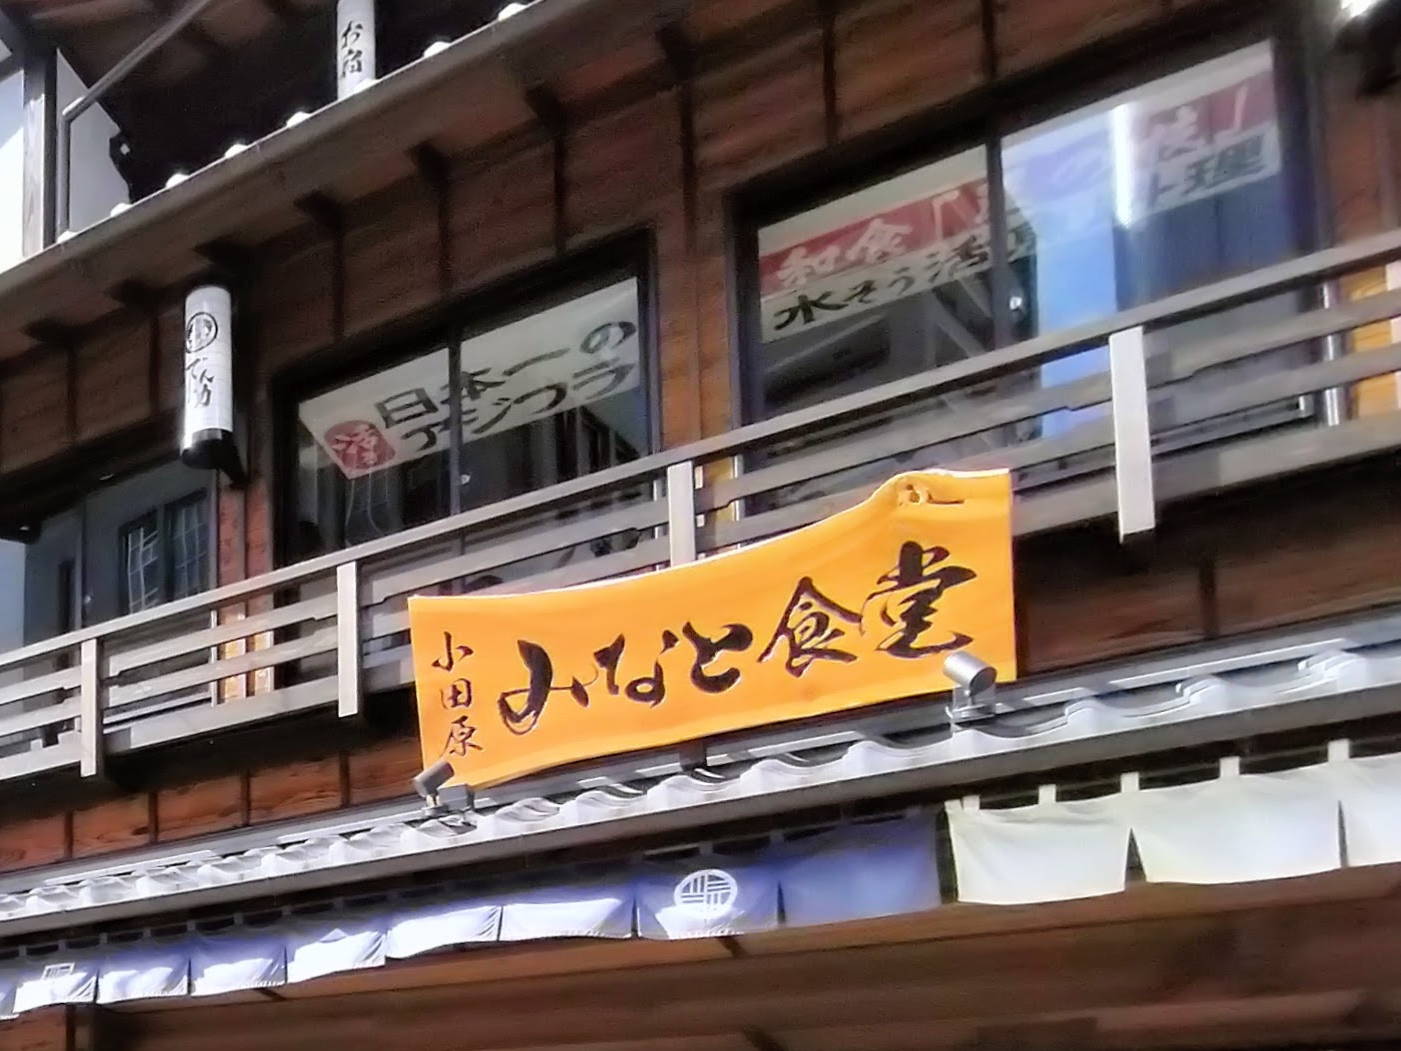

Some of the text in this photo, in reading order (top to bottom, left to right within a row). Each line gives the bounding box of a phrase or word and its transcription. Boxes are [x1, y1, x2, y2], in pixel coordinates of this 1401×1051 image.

[341, 20, 363, 79] お宿
[375, 320, 637, 429] 日本一の
[431, 631, 484, 757] 小田原
[496, 541, 977, 734] みなと食堂
